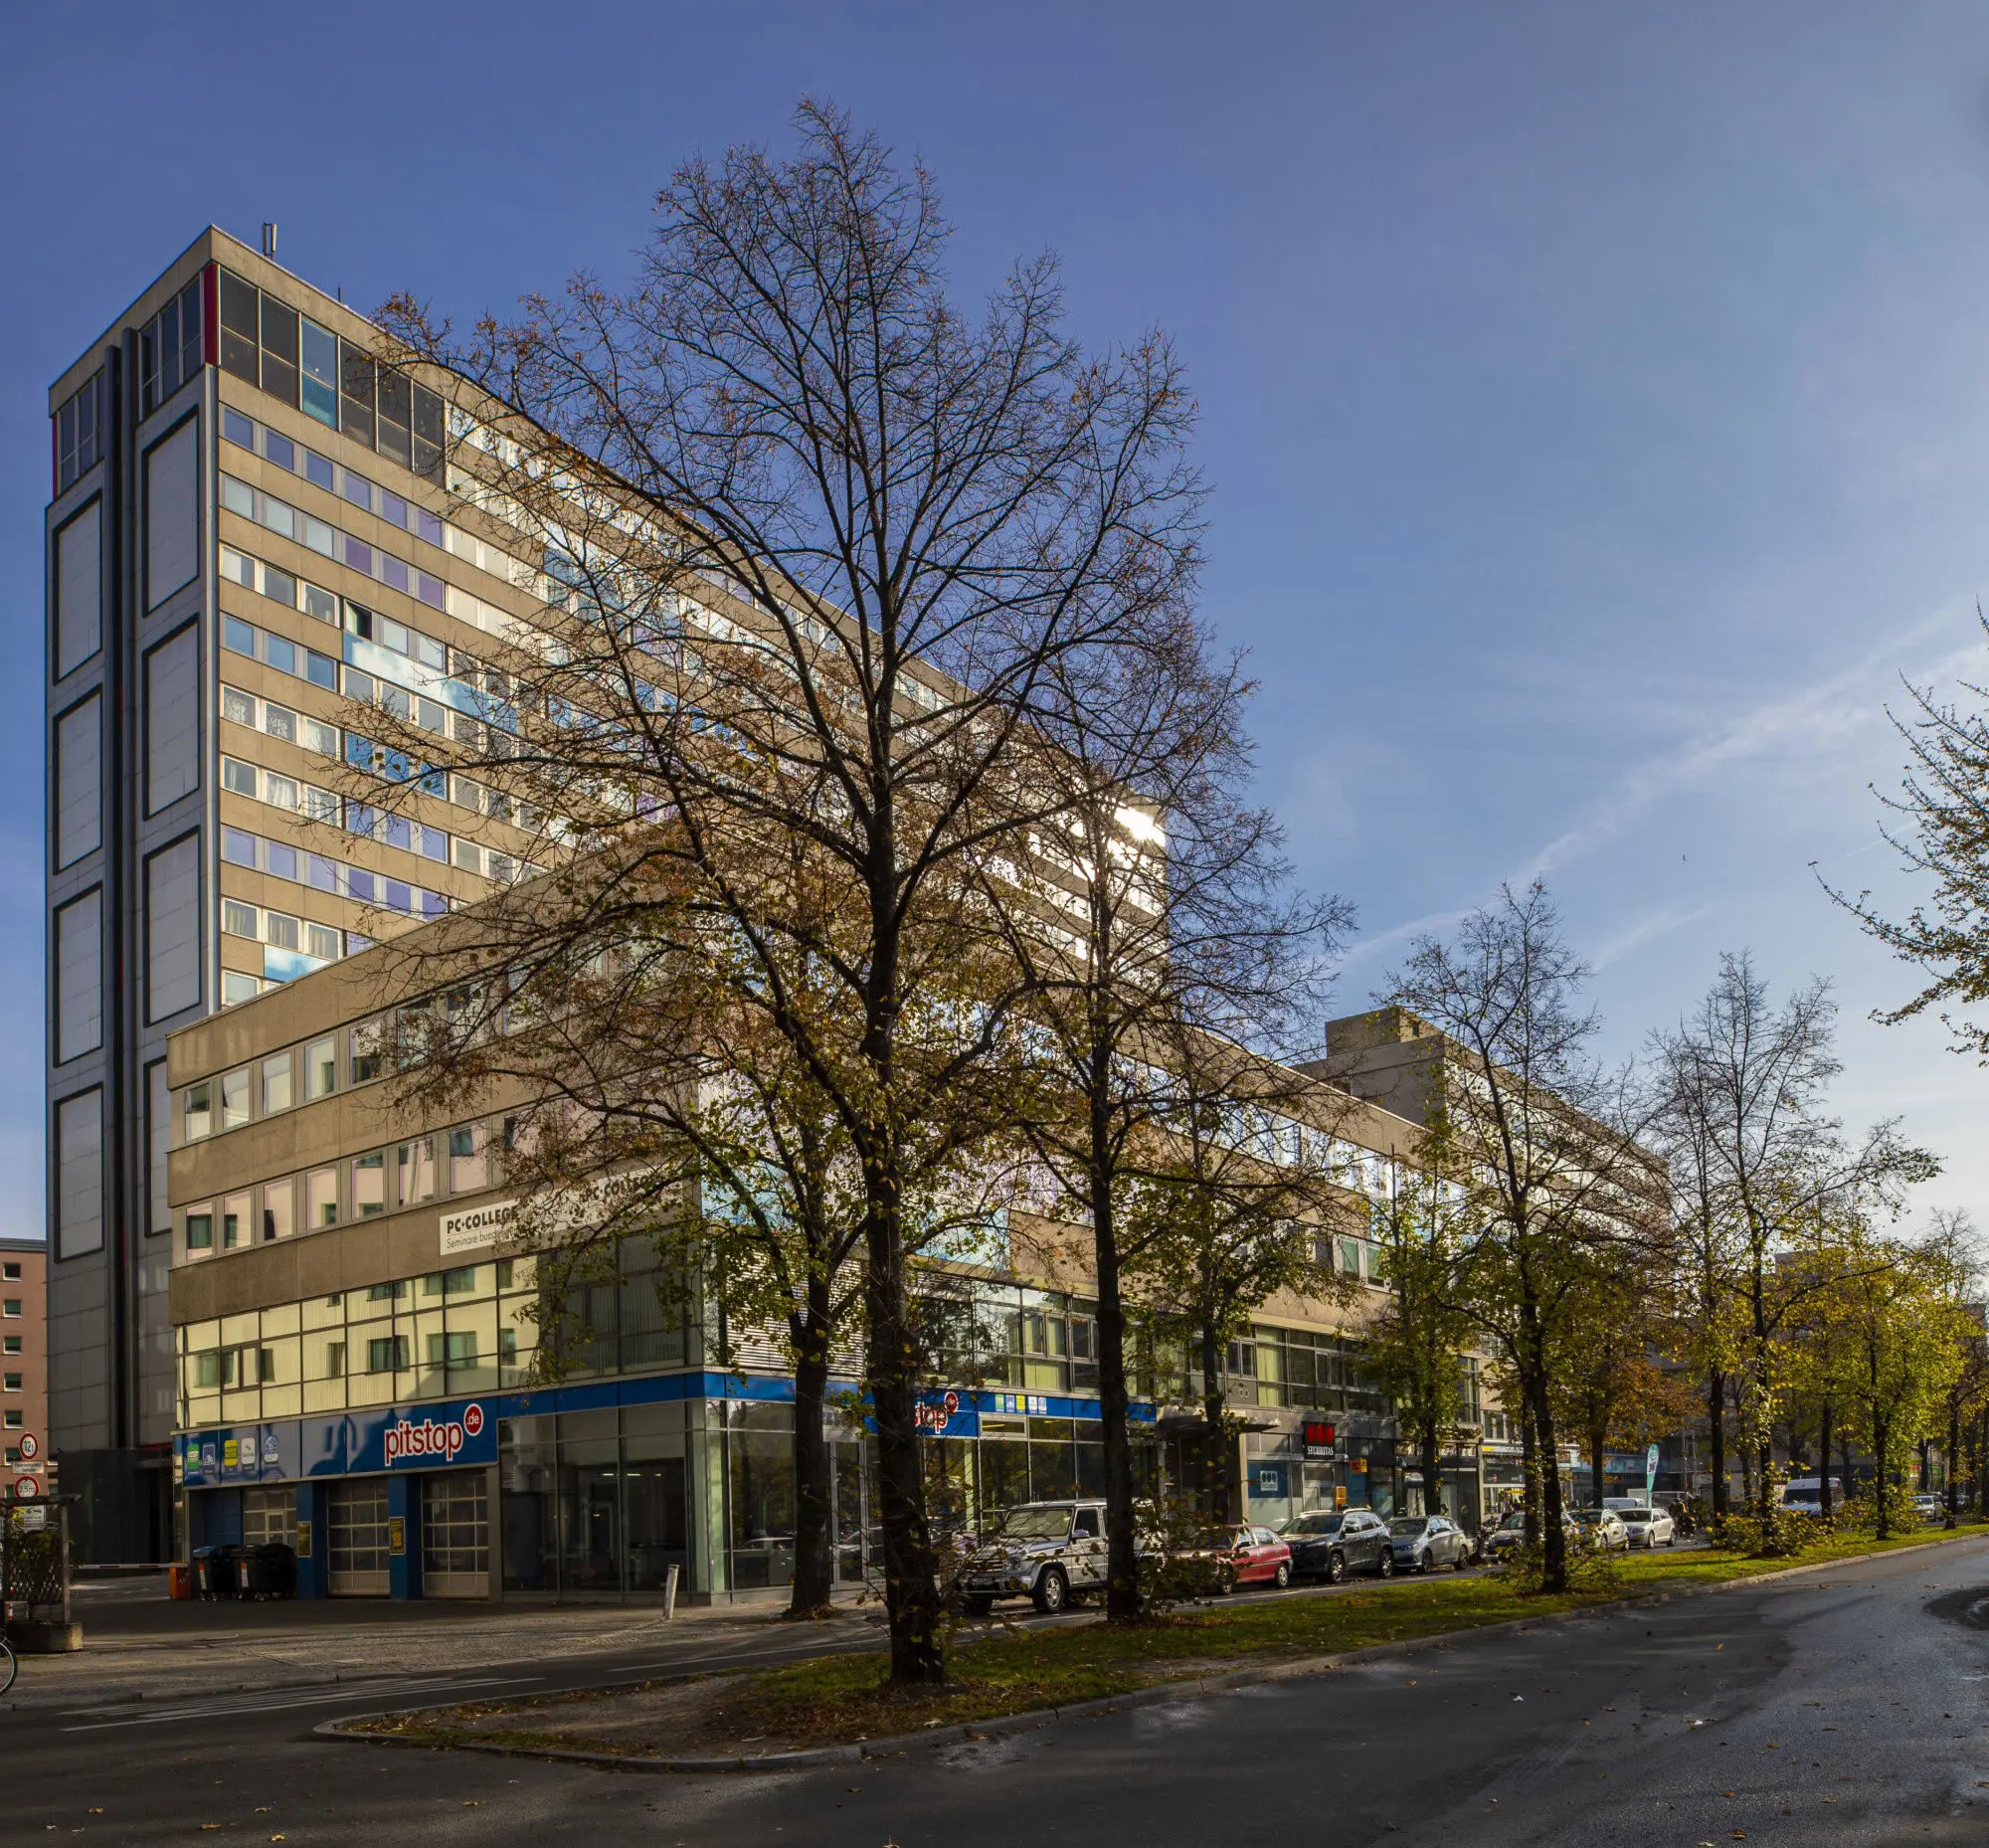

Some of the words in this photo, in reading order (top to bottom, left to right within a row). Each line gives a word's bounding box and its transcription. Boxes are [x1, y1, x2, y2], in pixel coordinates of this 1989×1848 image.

[446, 1233, 478, 1249] Seminare
[384, 1418, 463, 1466] pitstop
[1307, 1445, 1334, 1456] SECURITAS
